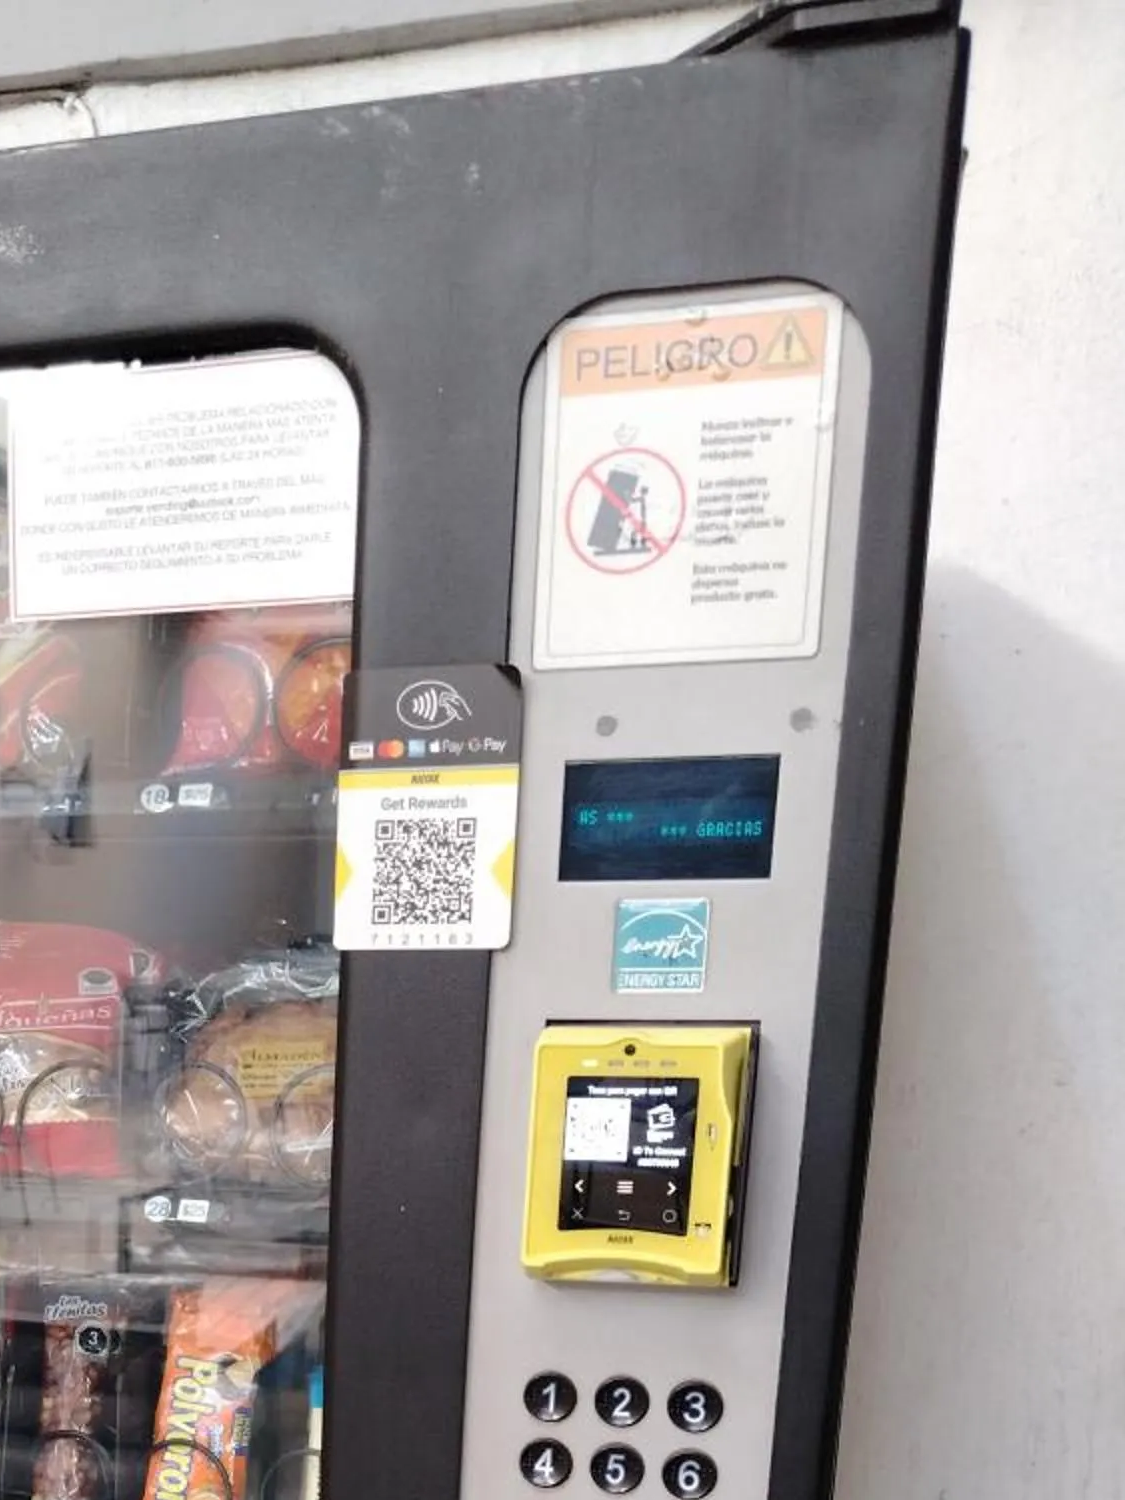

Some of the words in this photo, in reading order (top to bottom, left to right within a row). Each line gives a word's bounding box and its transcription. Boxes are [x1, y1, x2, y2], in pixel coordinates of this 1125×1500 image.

[576, 334, 757, 381] PELIGRO
[484, 737, 507, 754] Pay
[381, 797, 405, 811] Get
[408, 794, 469, 811] Rewards
[696, 820, 764, 838] GRACIAS
[666, 970, 701, 986] STAR
[149, 1198, 169, 1216] 28
[542, 1383, 556, 1413] 1
[612, 1388, 631, 1417] 2
[683, 1392, 705, 1422] 3
[534, 1449, 553, 1478] 4
[605, 1455, 624, 1484] 5
[679, 1460, 701, 1490] 6
